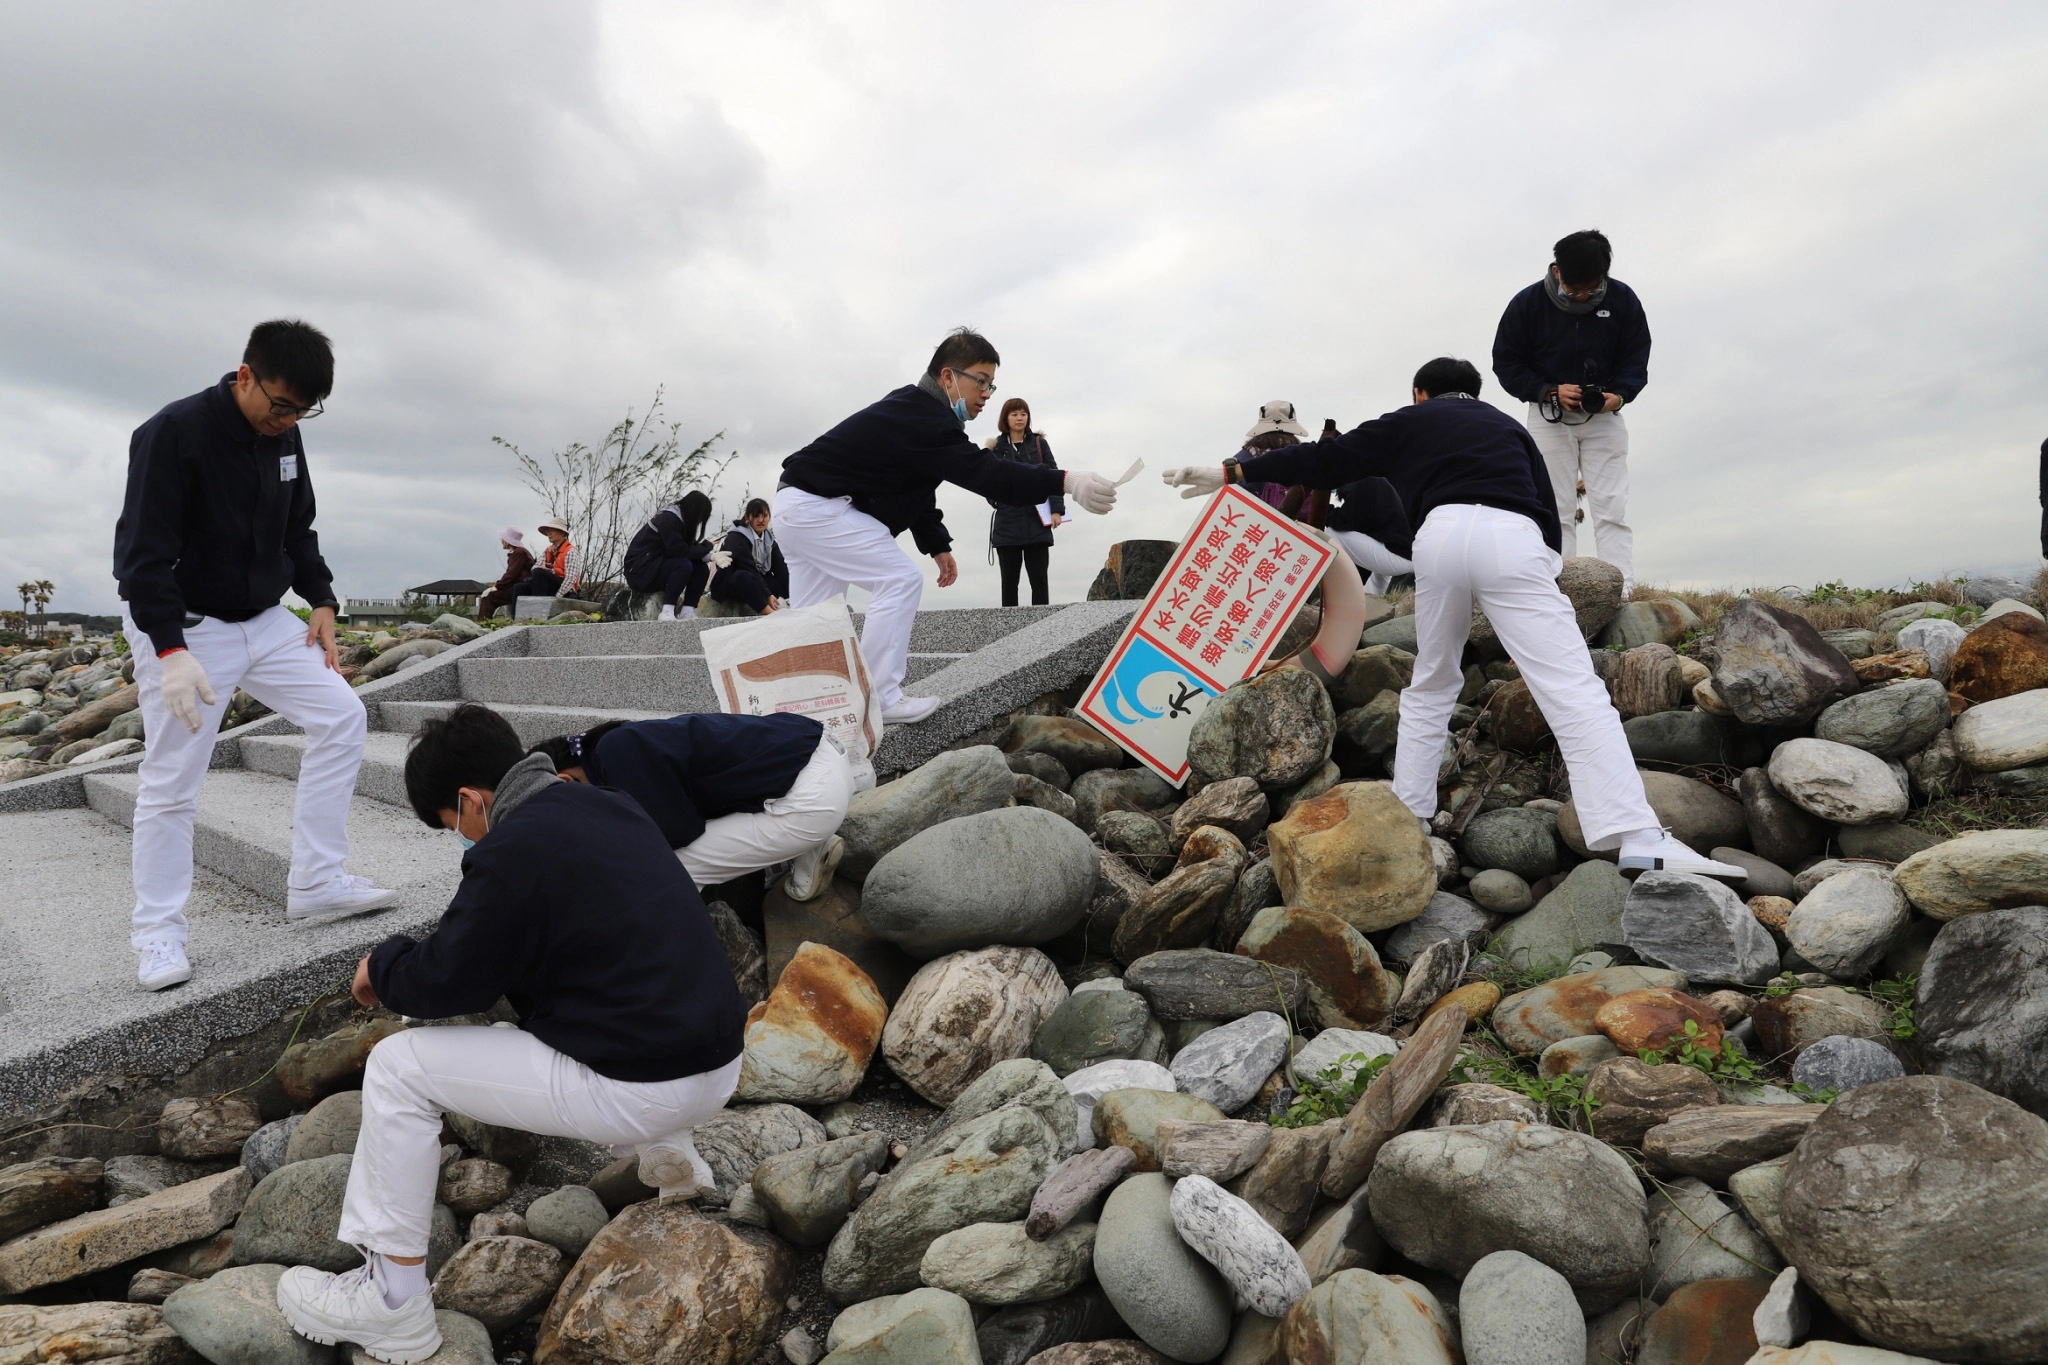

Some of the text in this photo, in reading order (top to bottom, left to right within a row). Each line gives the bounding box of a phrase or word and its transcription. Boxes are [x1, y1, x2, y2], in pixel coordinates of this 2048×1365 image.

[1154, 505, 1244, 631] 本水域海浪大
[1176, 524, 1269, 649] 請勿靠近海岸
[1200, 538, 1292, 666] 避免捲入溺水
[1250, 589, 1287, 639] 花蓮縣政府
